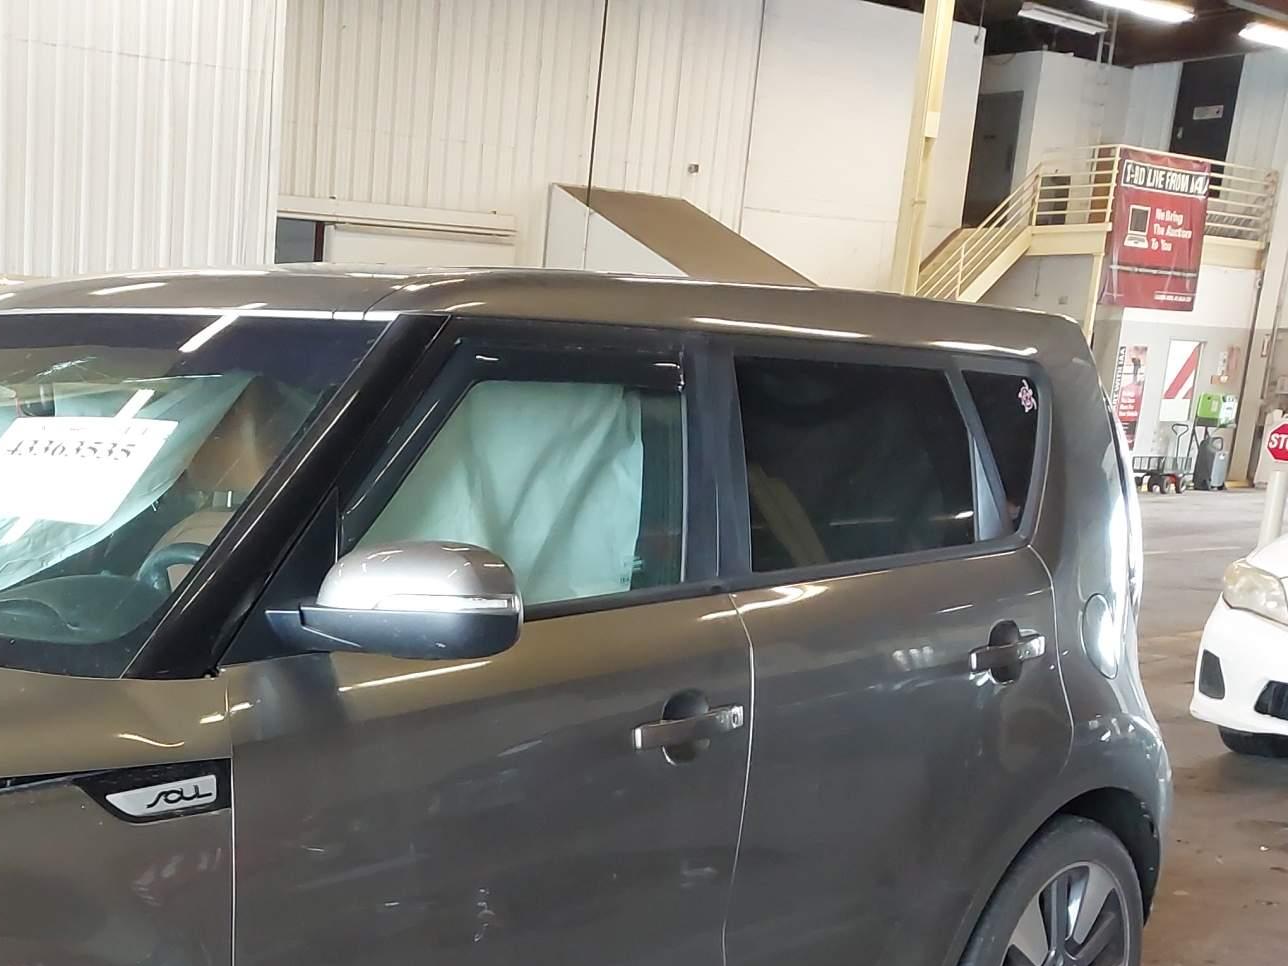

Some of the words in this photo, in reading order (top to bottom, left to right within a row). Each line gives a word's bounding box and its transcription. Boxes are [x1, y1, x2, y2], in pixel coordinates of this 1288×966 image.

[1146, 167, 1165, 189] LIVE
[1165, 171, 1190, 193] FROM
[1269, 433, 1288, 449] ST
